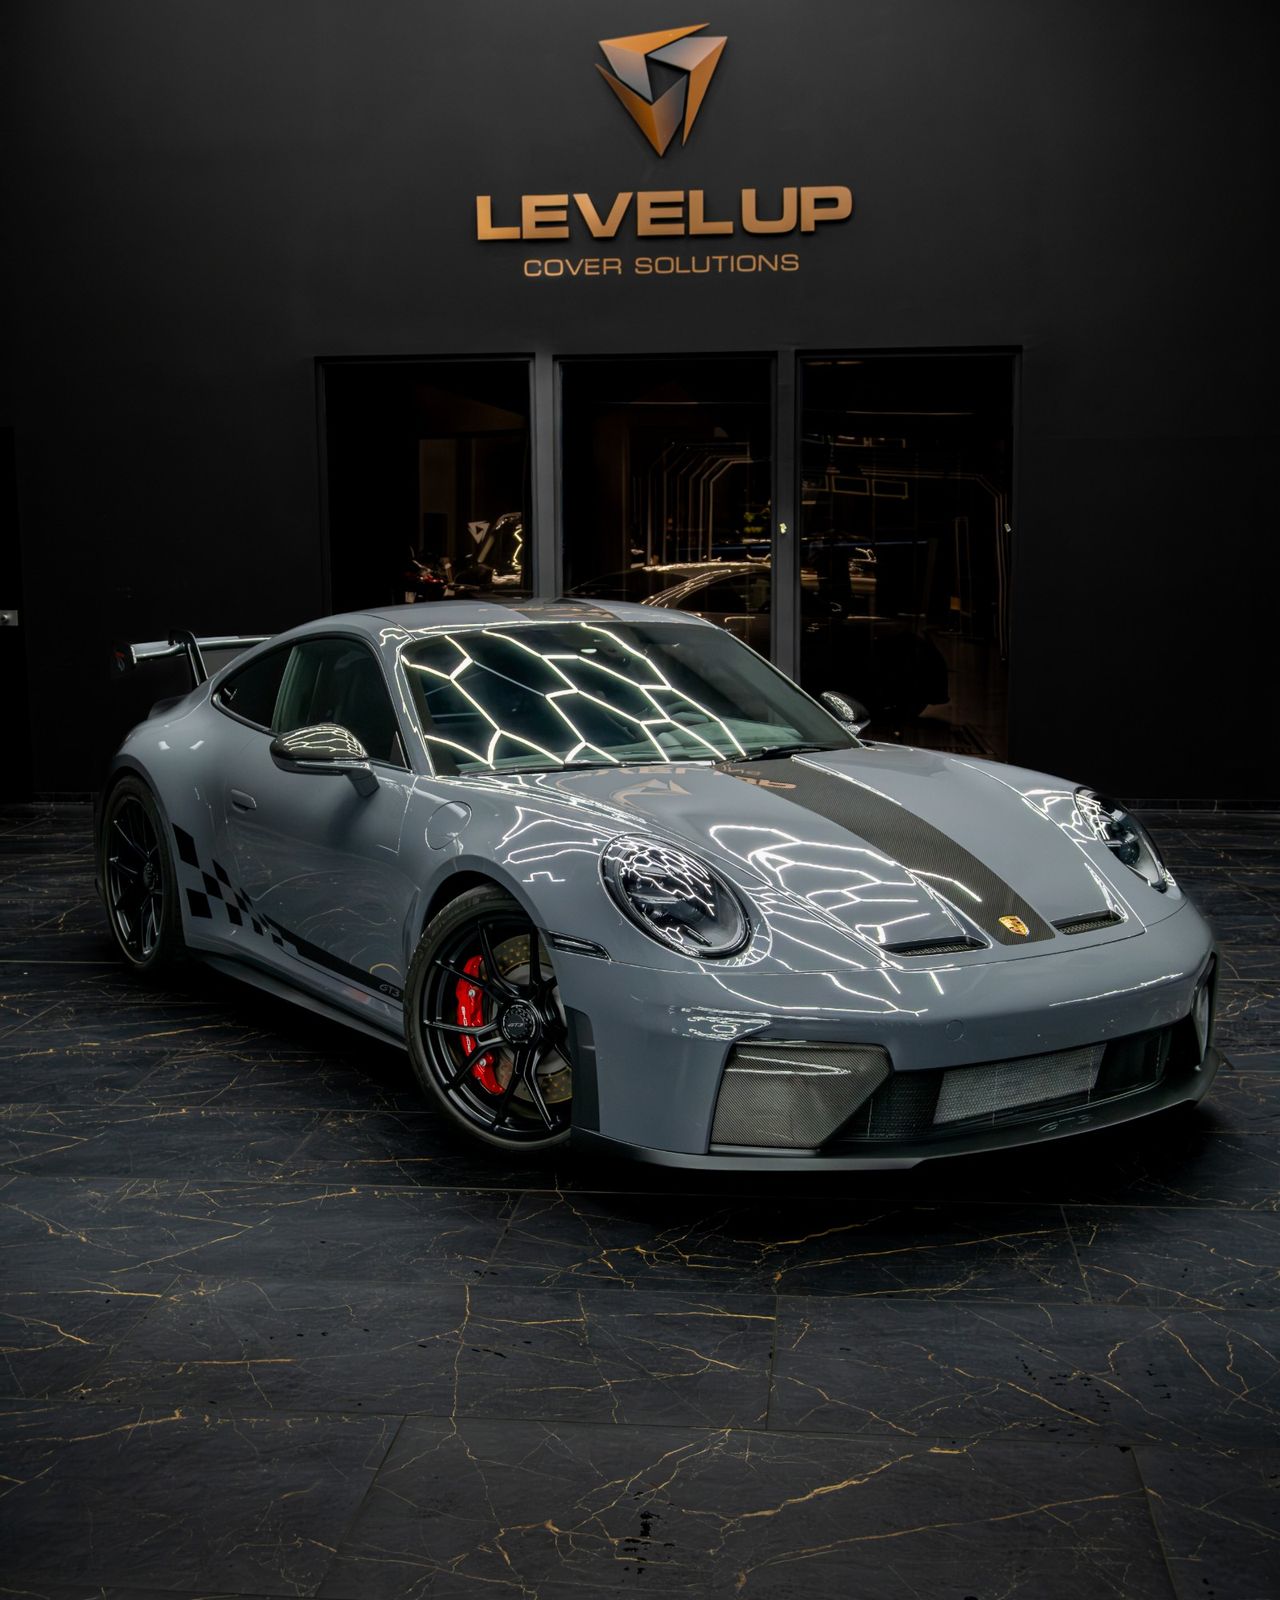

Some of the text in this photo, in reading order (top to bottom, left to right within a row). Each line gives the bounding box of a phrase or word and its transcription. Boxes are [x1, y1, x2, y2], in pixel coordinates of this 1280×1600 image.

[523, 253, 800, 277] COVER SOLUTIONS
[379, 983, 400, 998] GT3
